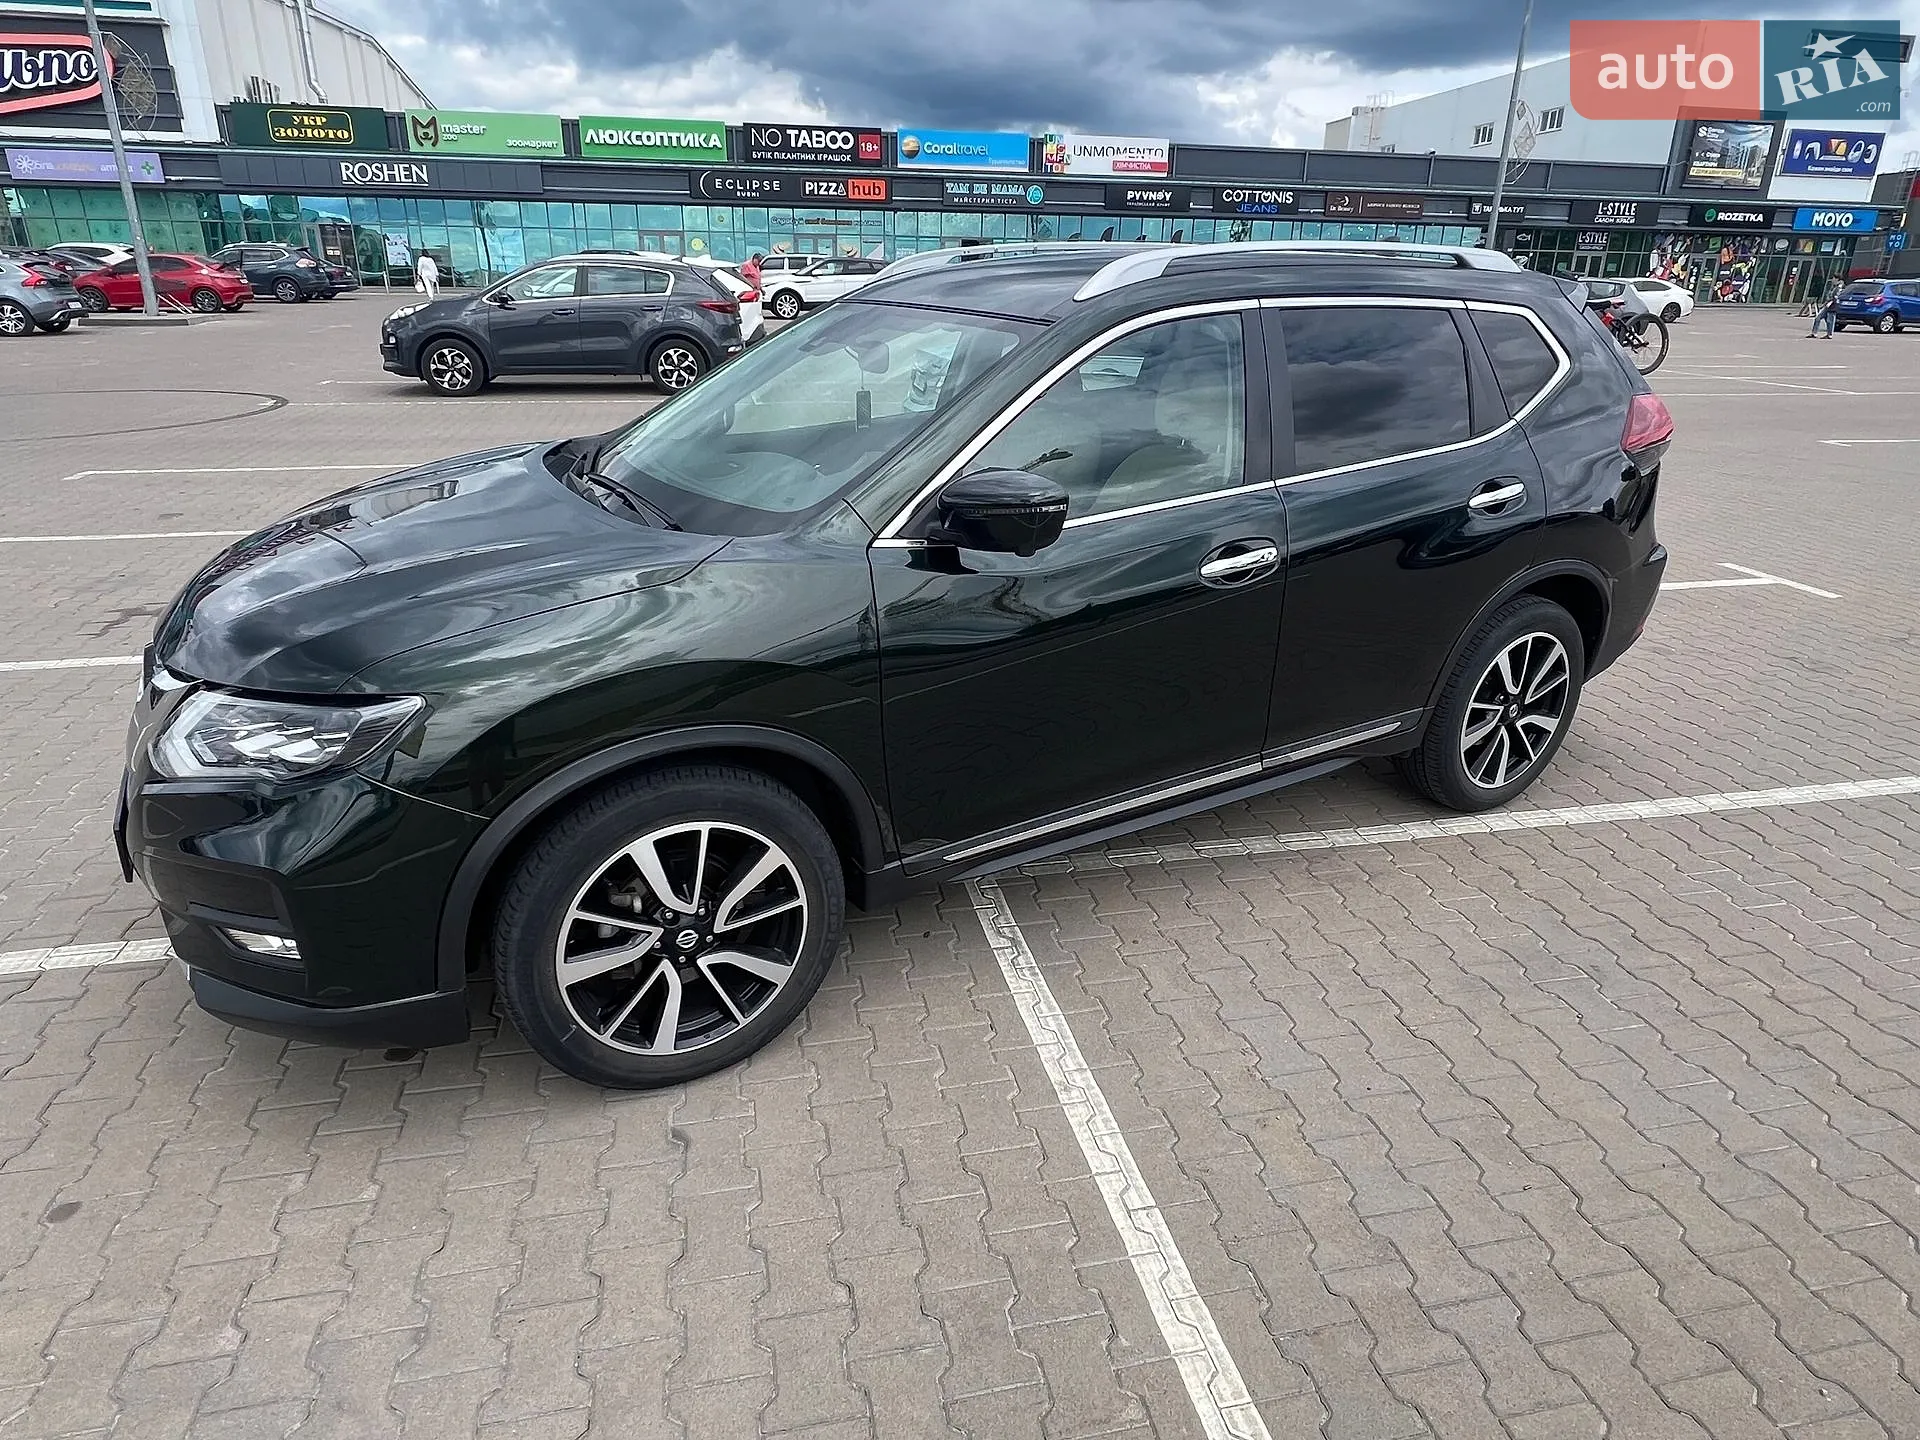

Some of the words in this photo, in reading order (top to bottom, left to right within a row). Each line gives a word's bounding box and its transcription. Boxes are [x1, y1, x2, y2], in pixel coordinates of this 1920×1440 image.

[291, 114, 328, 126] УКР
[274, 127, 350, 140] ЗОЛОТО
[440, 123, 487, 135] master
[506, 138, 559, 150] зоомаркет
[584, 128, 723, 149] ЛЮКСОПТИКА
[751, 127, 782, 147] NO
[786, 128, 855, 150] TABOO
[860, 142, 879, 152] 18+
[752, 151, 772, 160] БУТІК
[817, 152, 852, 162] ІГРАШОК
[340, 161, 429, 185] ROSHEN
[714, 178, 781, 191] ECLIPSE
[805, 181, 847, 196] PIZZA
[852, 181, 882, 196] hub
[1222, 189, 1294, 204] COTTONIS
[1236, 203, 1278, 213] JEANS
[1598, 202, 1638, 216] L-STYLE
[1717, 211, 1764, 223] ROZETKA
[1812, 212, 1854, 228] MOYO
[1578, 231, 1609, 244] L-STYLE
